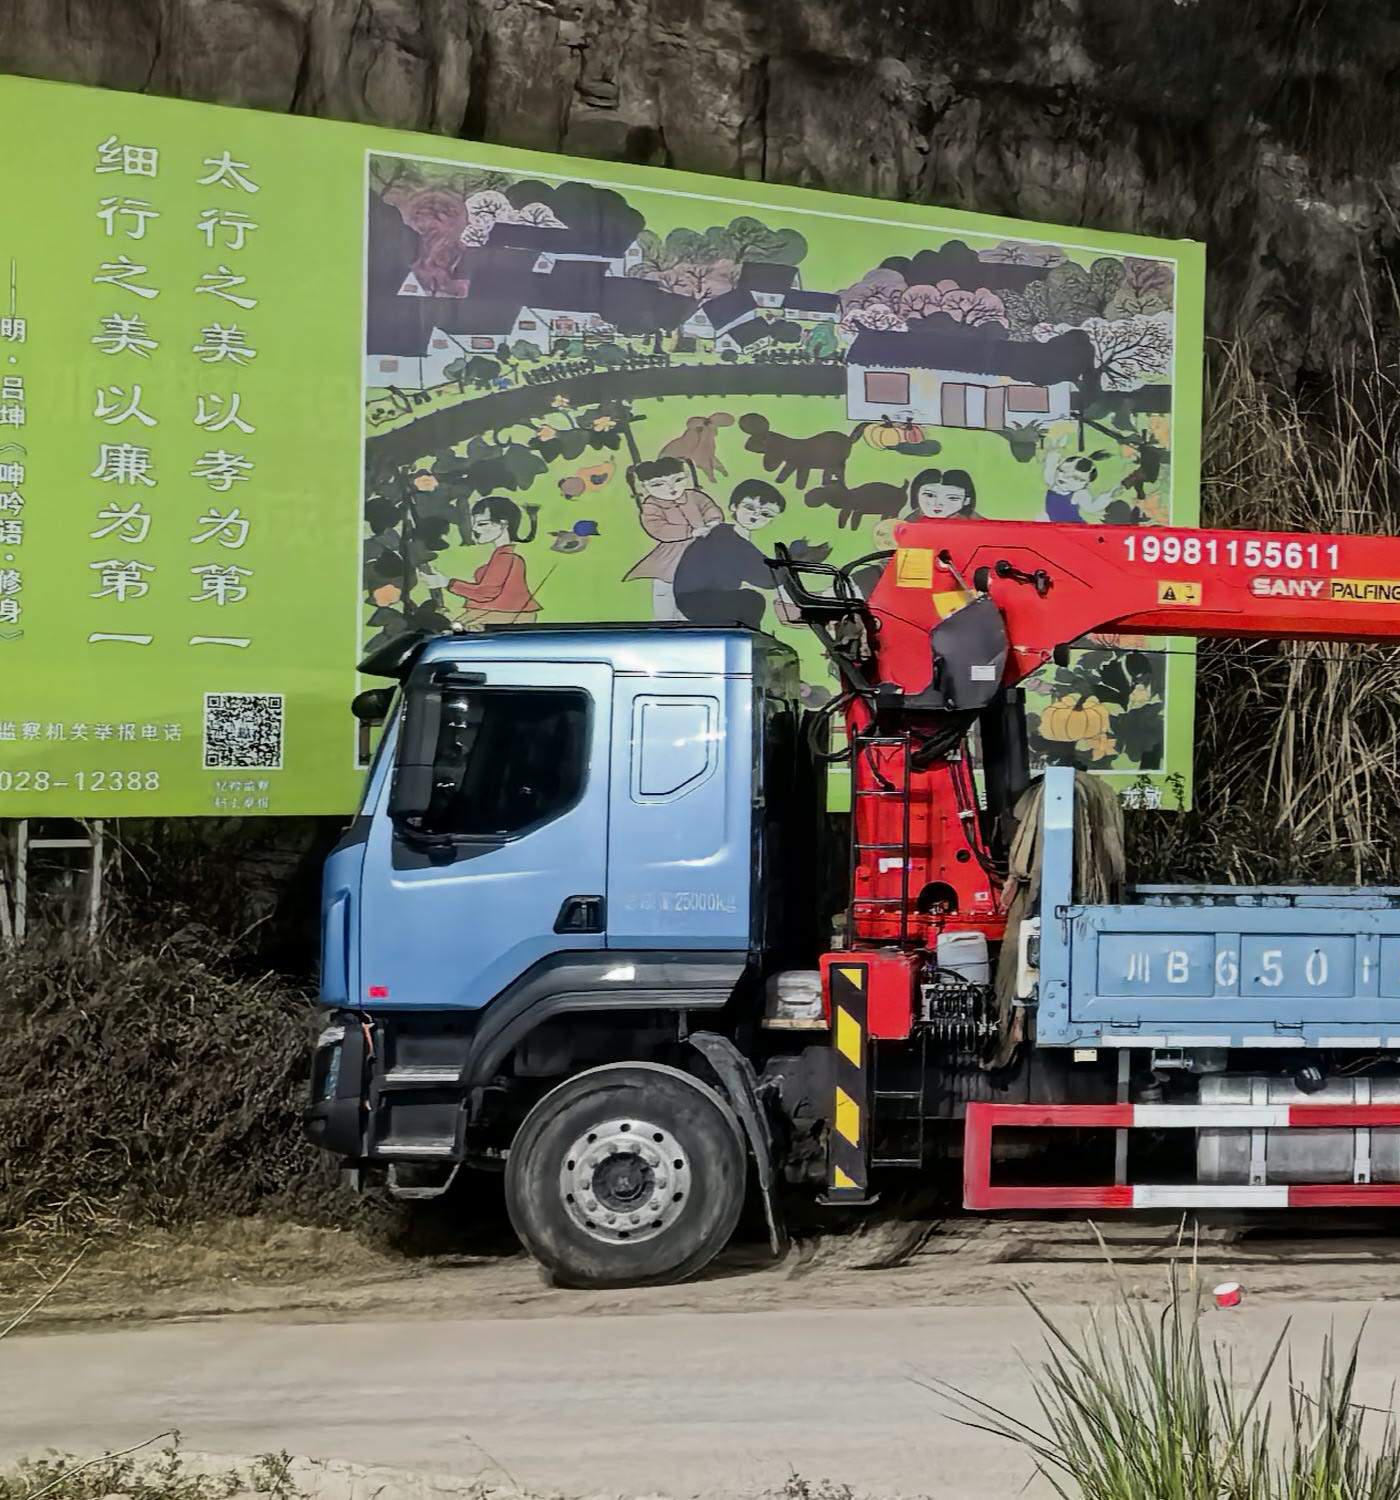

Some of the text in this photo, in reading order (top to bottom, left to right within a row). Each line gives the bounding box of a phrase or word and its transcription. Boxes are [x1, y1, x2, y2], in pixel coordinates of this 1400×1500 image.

[88, 135, 161, 647] 细行之美以廉为第一
[189, 150, 261, 649] 太行之美以孝为第一
[1123, 534, 1341, 571] 19981155611
[1251, 577, 1324, 599] SANY
[0, 770, 161, 792] 028-12388
